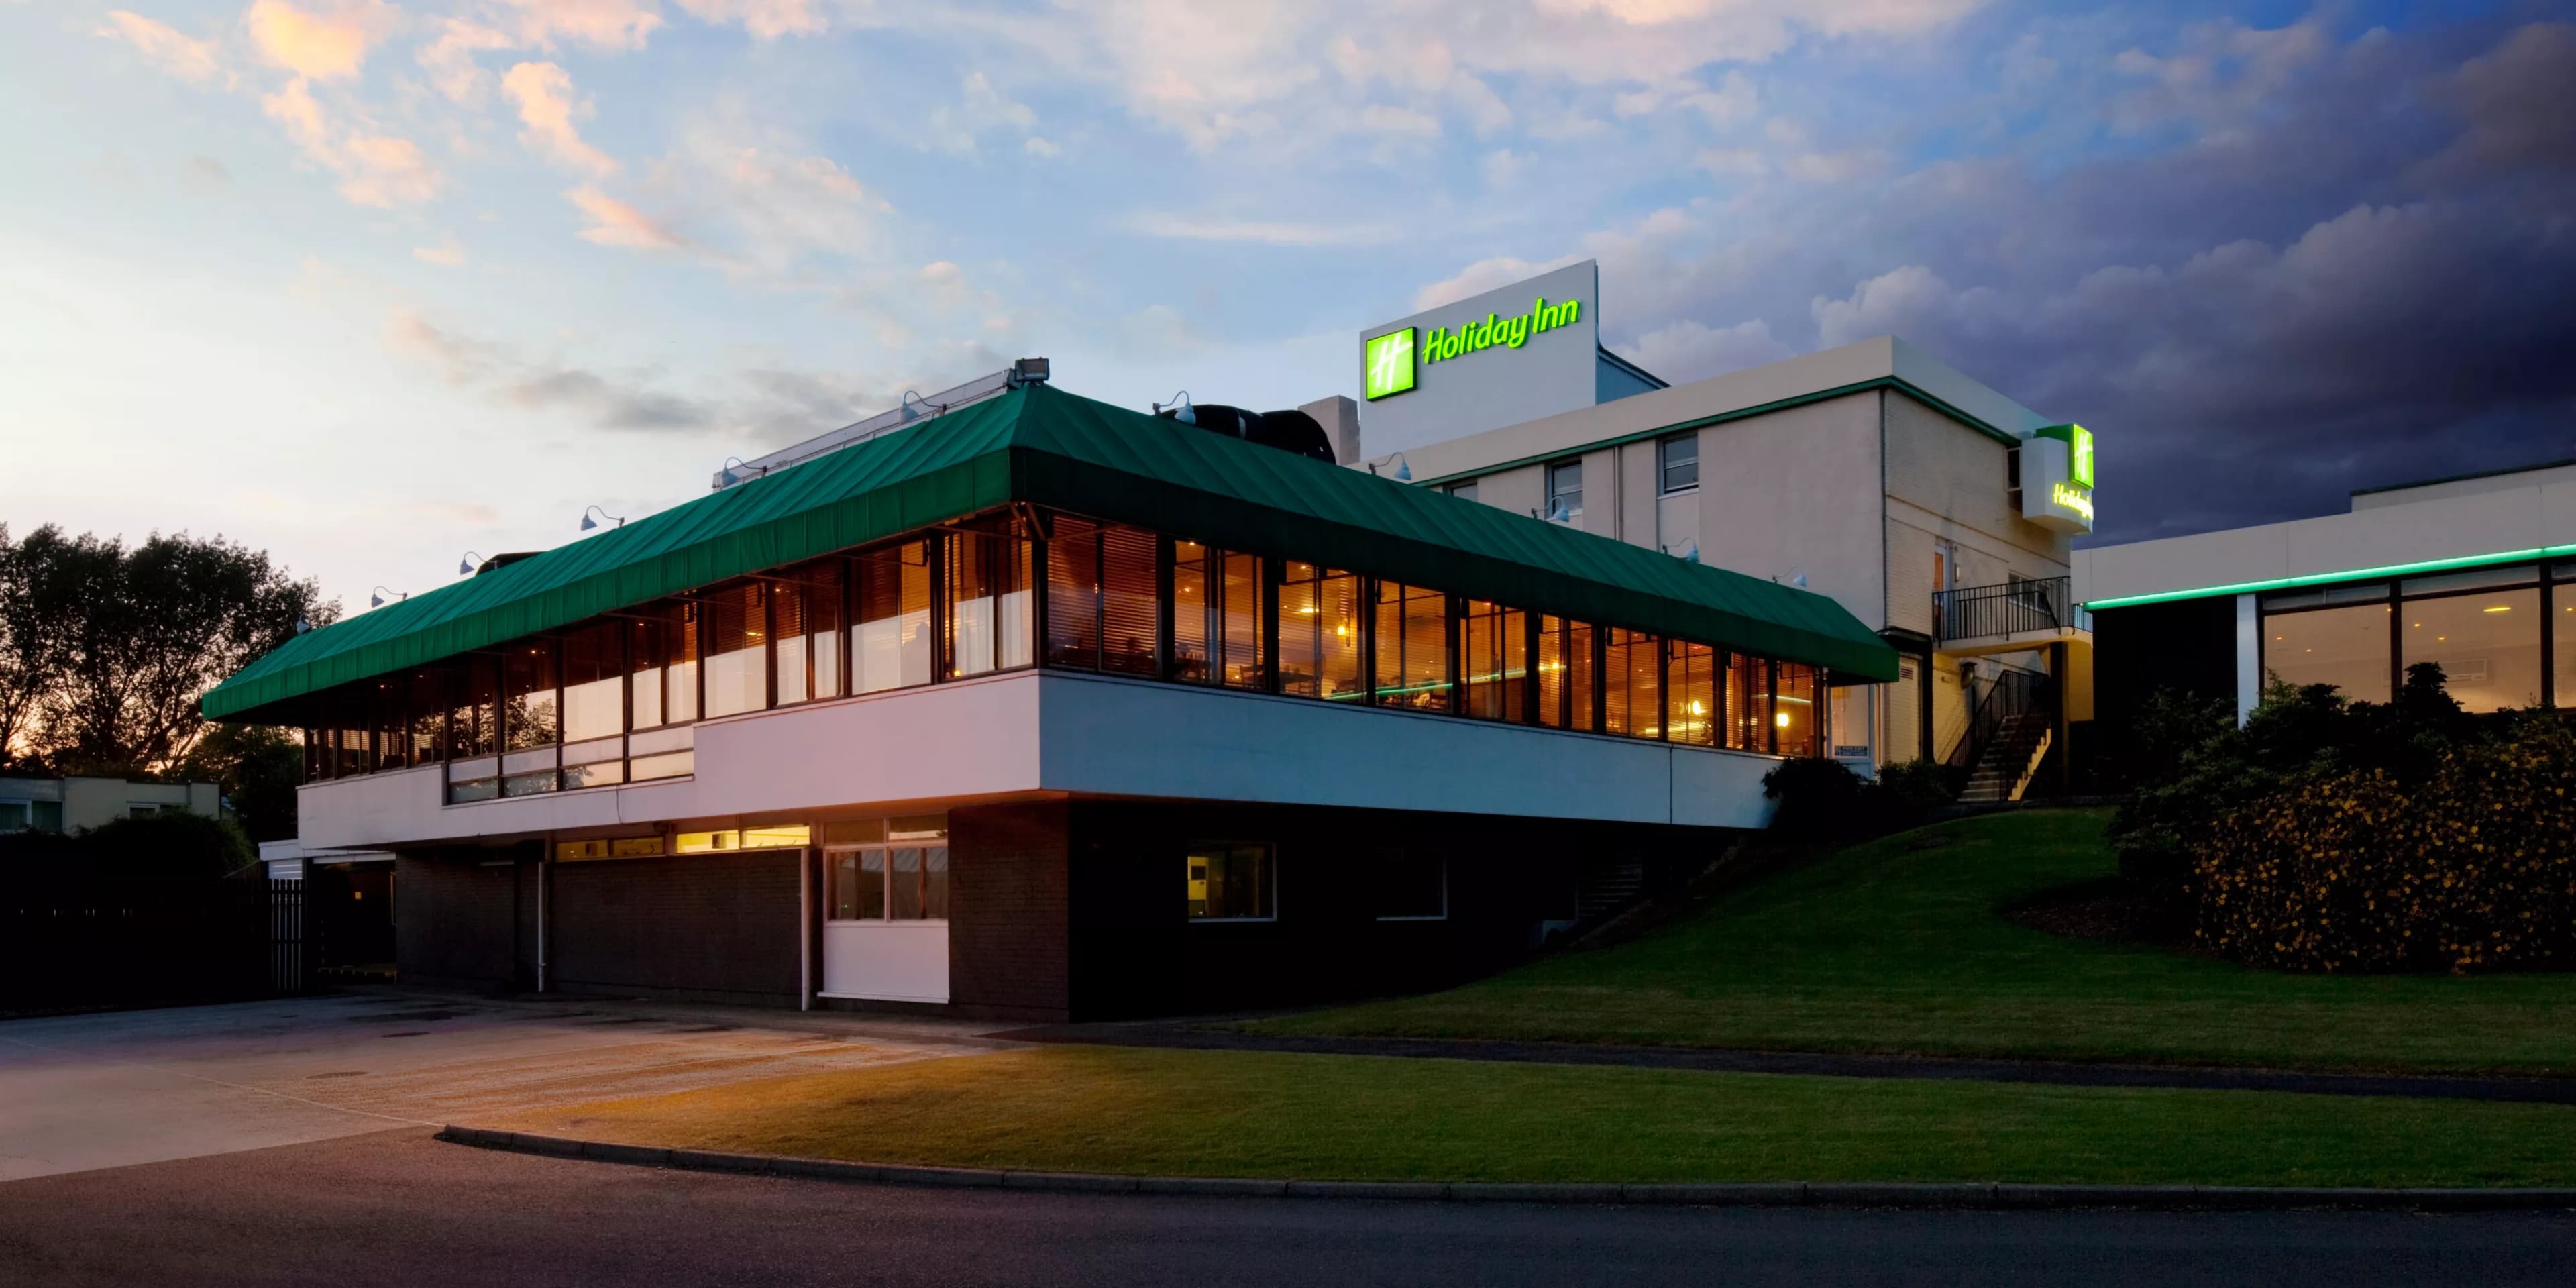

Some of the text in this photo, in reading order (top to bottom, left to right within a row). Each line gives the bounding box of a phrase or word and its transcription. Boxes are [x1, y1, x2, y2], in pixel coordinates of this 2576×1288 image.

[1422, 297, 1580, 364] Holiday Inn
[1371, 333, 1413, 391] H
[2053, 482, 2090, 519] Holid
